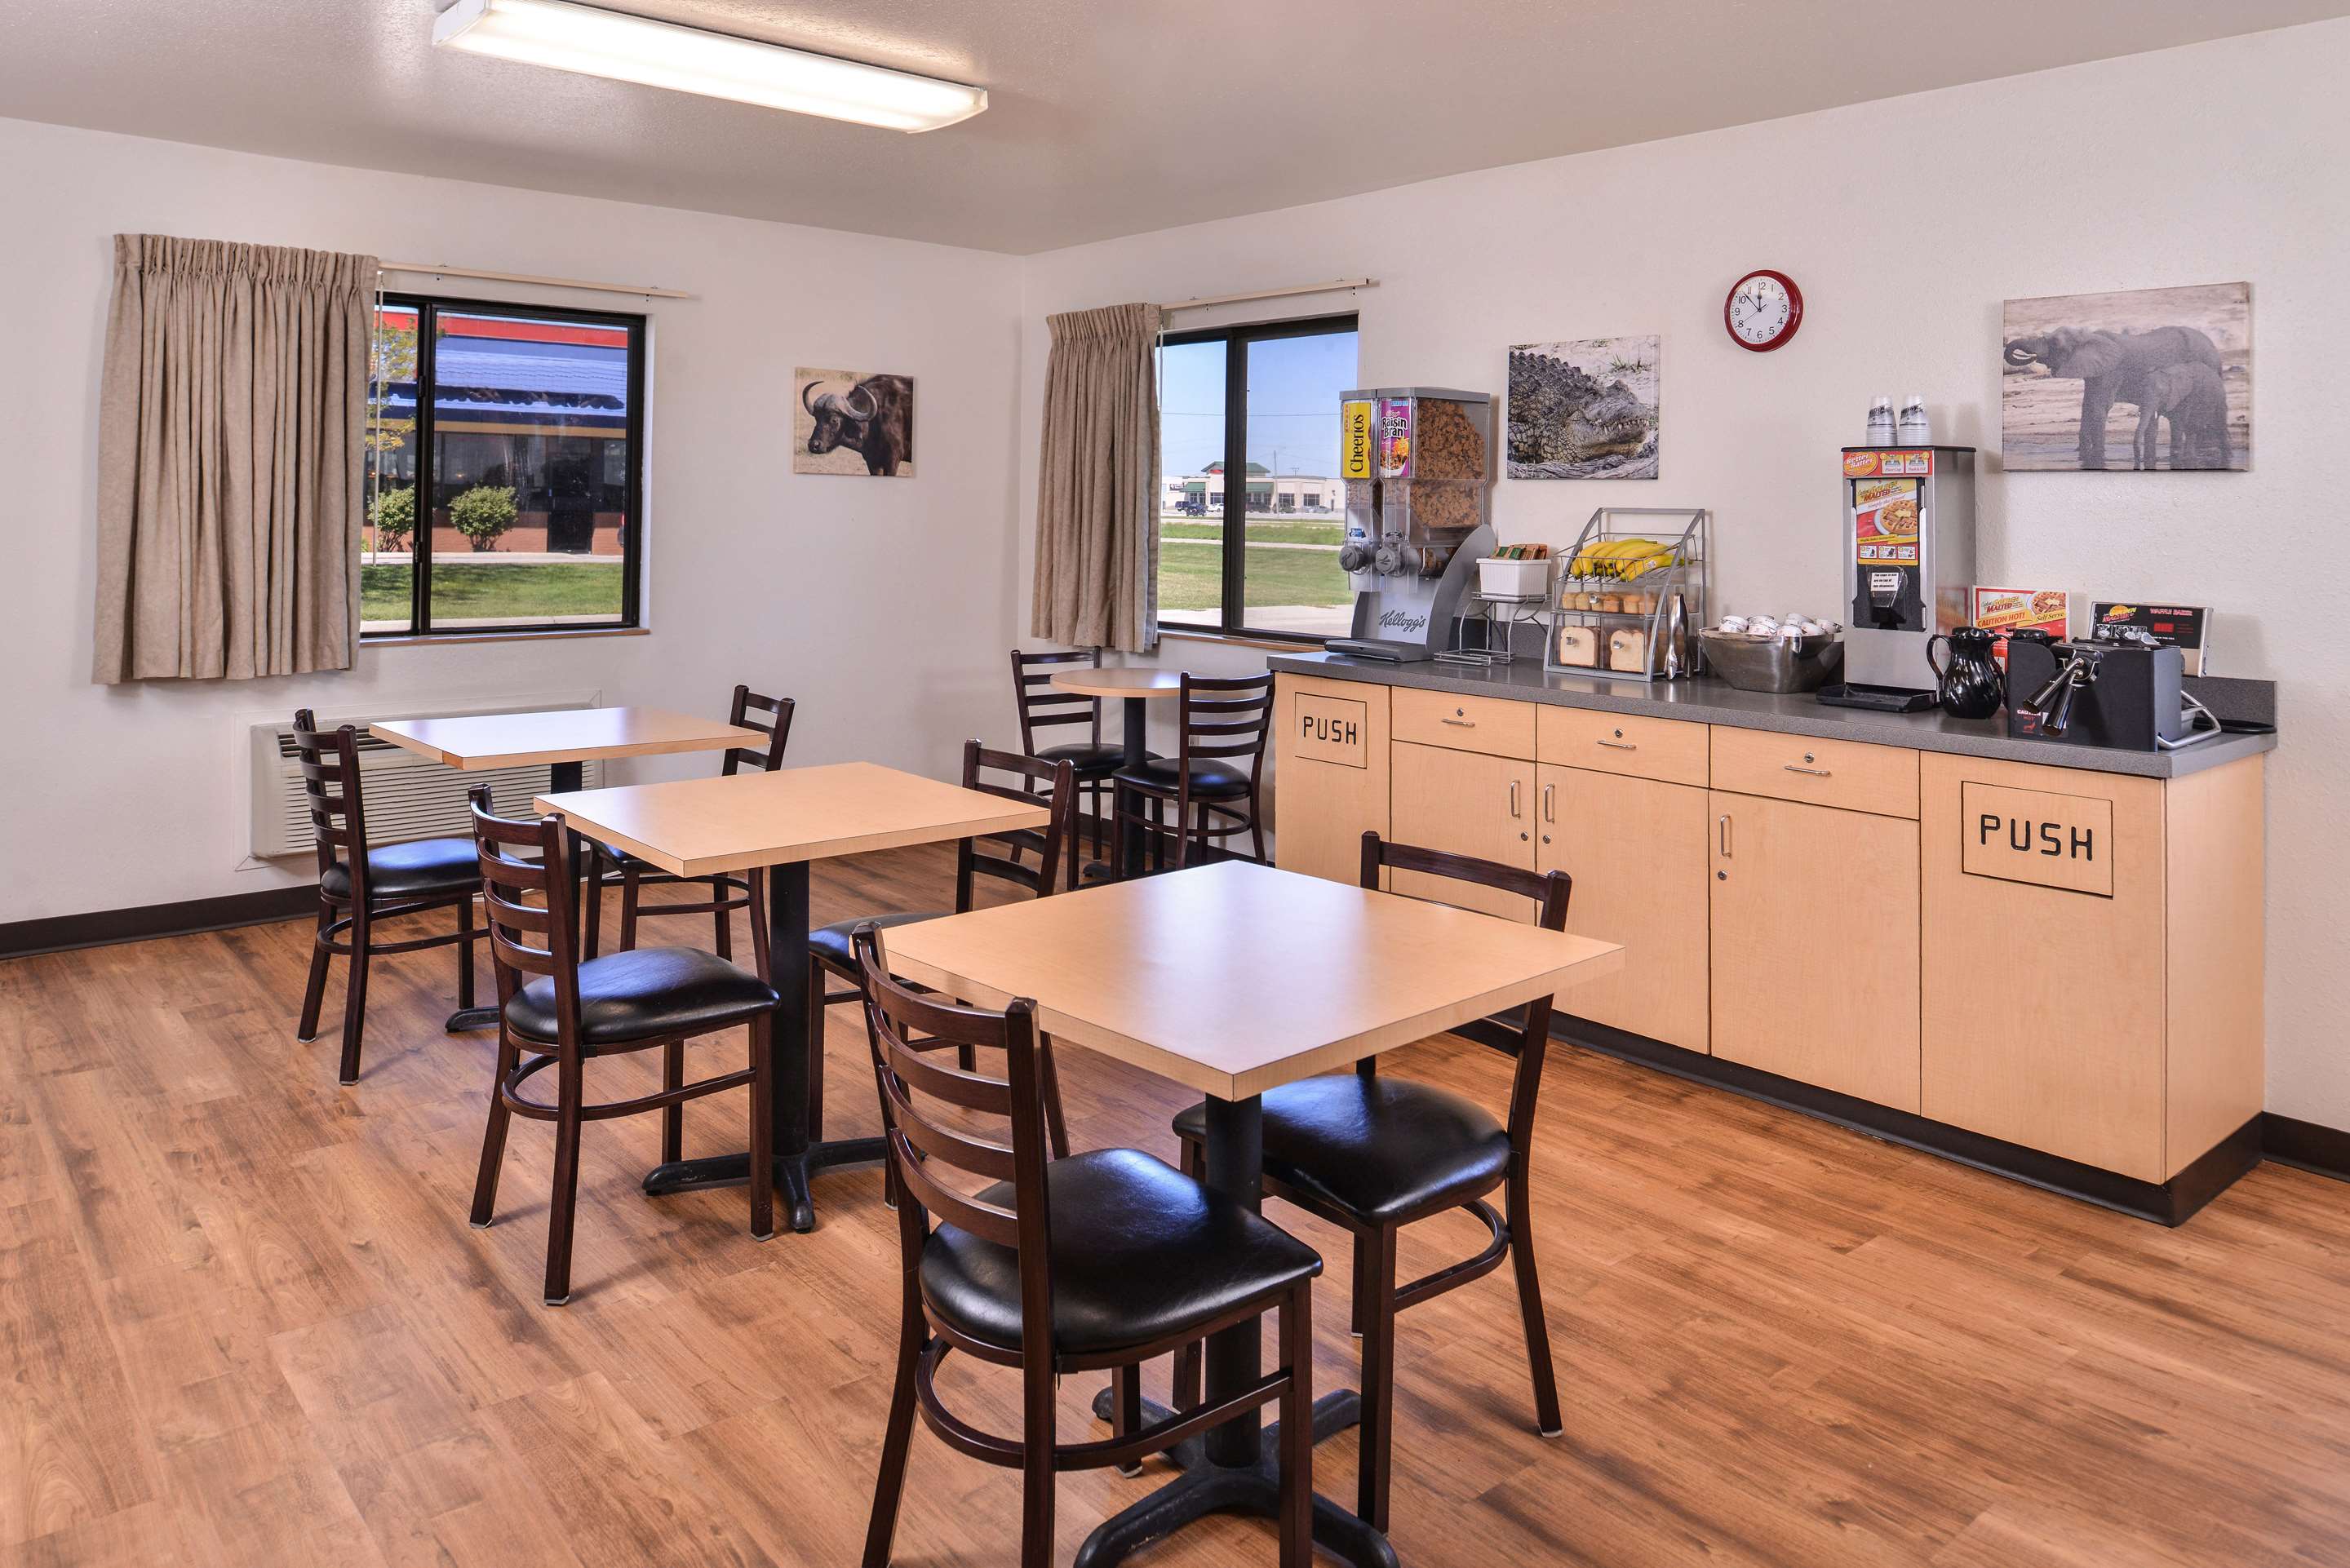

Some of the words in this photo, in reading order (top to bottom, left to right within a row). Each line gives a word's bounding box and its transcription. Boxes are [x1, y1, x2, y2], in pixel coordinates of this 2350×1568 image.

[1735, 308, 1740, 316] 9
[1746, 328, 1751, 336] 7
[1757, 330, 1762, 339] 6
[1381, 417, 1408, 429] Raisin
[1384, 427, 1403, 437] Bran
[1350, 414, 1363, 472] Cheerios
[1847, 454, 1869, 464] Better
[1851, 458, 1873, 468] Batter
[1864, 489, 1891, 501] MALTED
[1987, 603, 2012, 613] MALTED
[1379, 609, 1426, 632] Kellogg's
[1977, 613, 2007, 627] CAUTION
[2009, 612, 2025, 621] HOT!
[2037, 613, 2047, 622] Self
[2048, 612, 2064, 620] Serve
[1303, 715, 1356, 745] PUSH
[1980, 814, 2092, 861] PUSH
